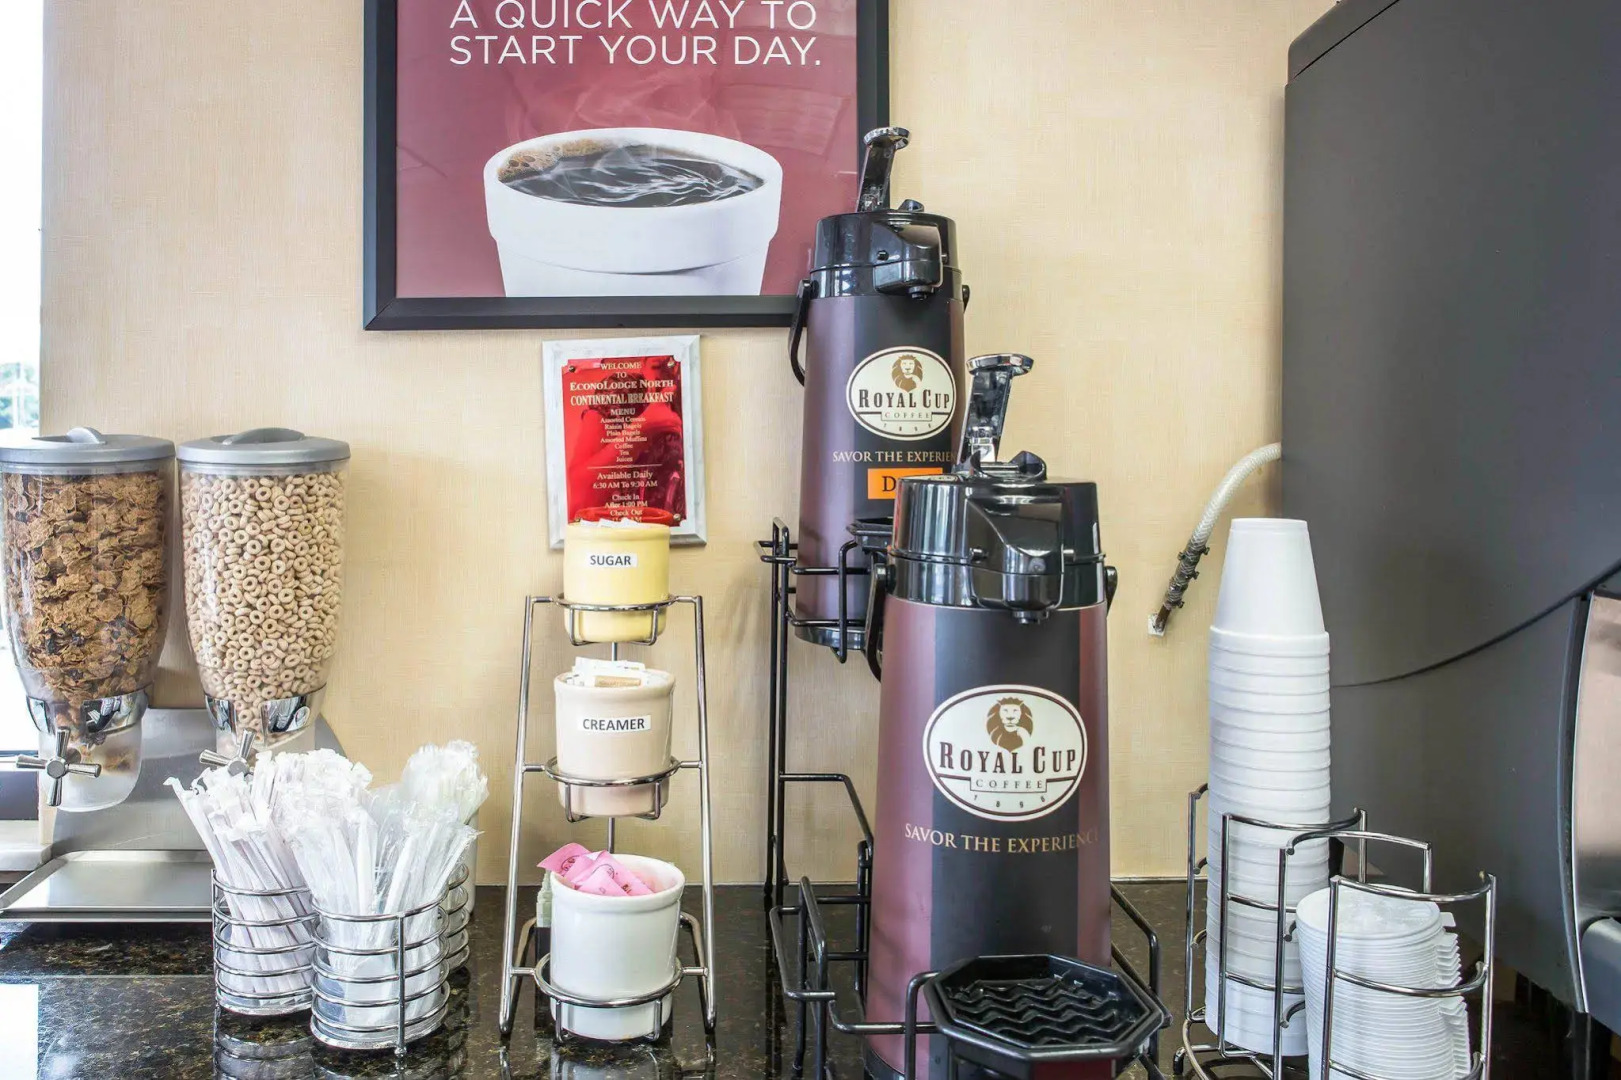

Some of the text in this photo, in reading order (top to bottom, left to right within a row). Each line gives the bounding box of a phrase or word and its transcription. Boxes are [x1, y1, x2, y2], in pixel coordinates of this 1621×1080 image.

[450, 0, 817, 30] A QUICK WAY TO
[450, 35, 821, 66] START YOUR DAY.
[601, 361, 642, 371] WELCOME
[616, 371, 627, 379] TO
[639, 379, 674, 389] NORTH
[570, 392, 674, 406] CONTINENTAL BREAKFAST
[859, 389, 950, 409] ROYAL CUP
[610, 408, 636, 416] MENU
[885, 412, 930, 420] COFFEE
[832, 451, 872, 462] SAVOR
[875, 452, 903, 462] THE
[597, 470, 653, 480] Available Daily
[645, 480, 658, 488] AM
[604, 501, 620, 509] After
[610, 508, 643, 517] Check Out
[590, 554, 632, 566] SUGAR
[582, 718, 645, 731] CREAMER
[939, 742, 1076, 774] ROYAL CUP
[976, 779, 1042, 789] COFFEE
[905, 823, 957, 849] SAVOR
[961, 834, 1001, 852] THE
